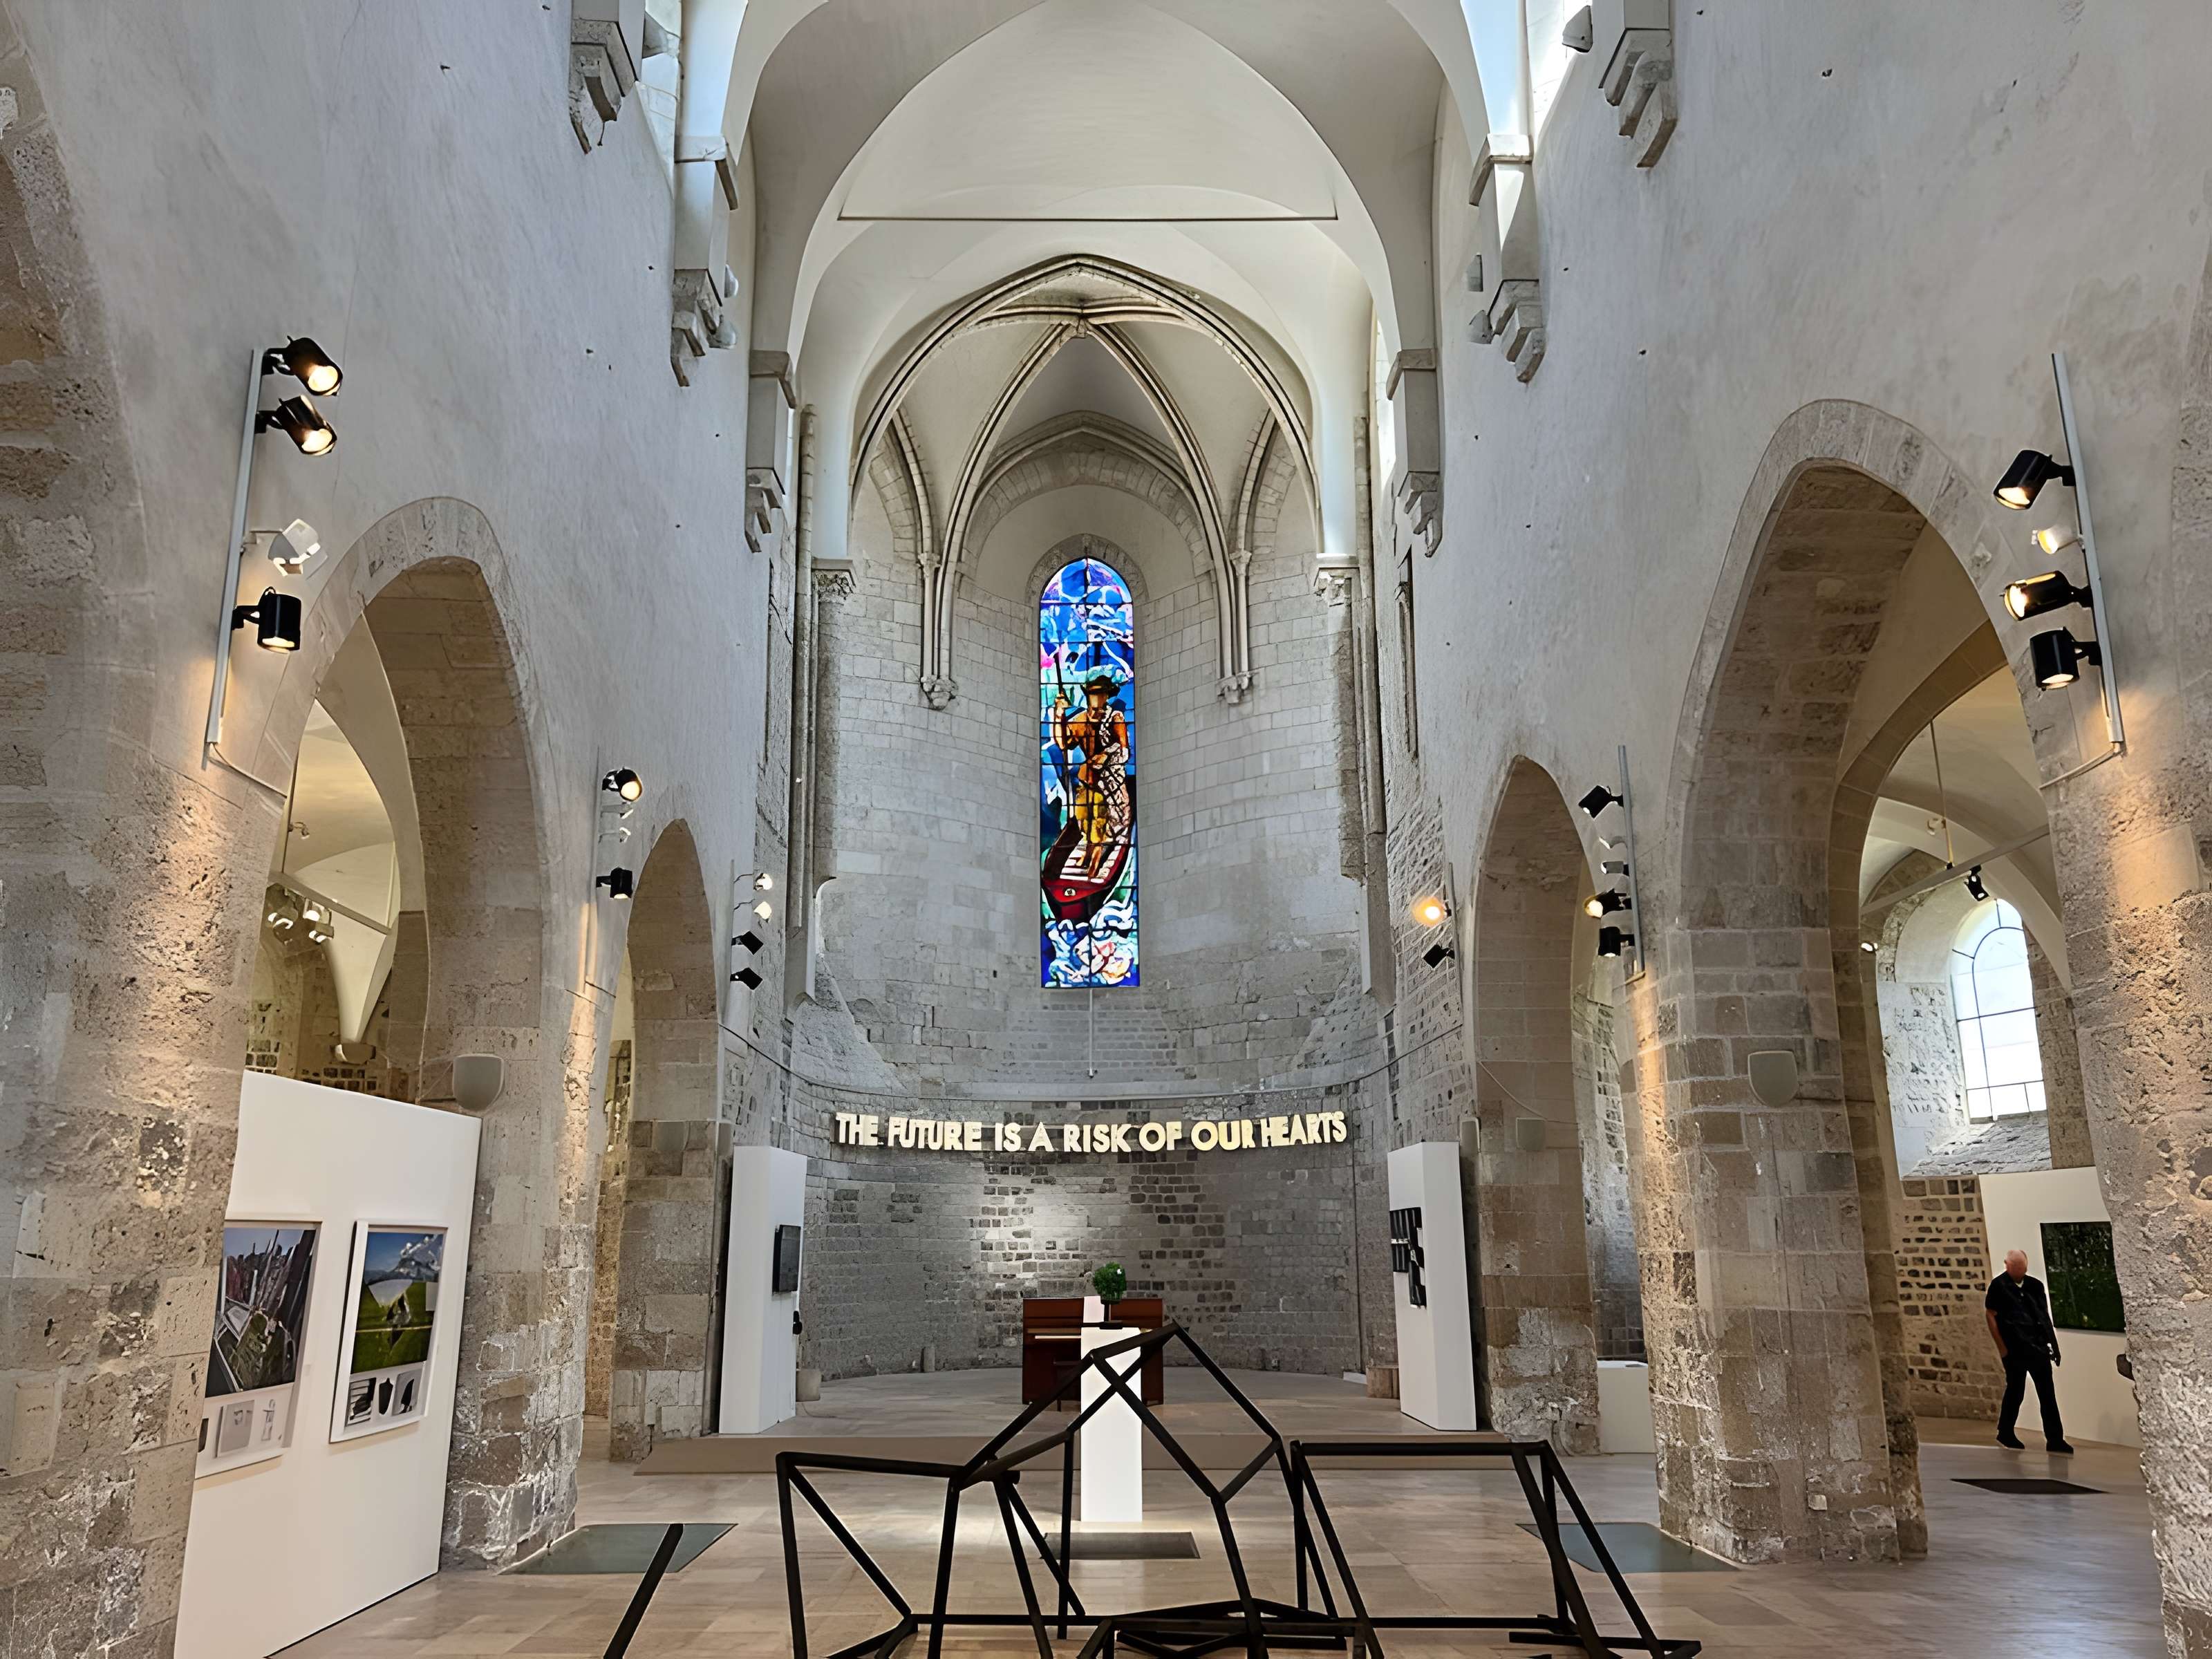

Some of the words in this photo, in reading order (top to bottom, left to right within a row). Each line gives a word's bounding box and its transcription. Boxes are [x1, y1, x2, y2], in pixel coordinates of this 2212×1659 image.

[835, 1112, 879, 1146] THE
[888, 1116, 982, 1151] FUTURE
[995, 1122, 1022, 1152] IS
[1028, 1121, 1054, 1152] A
[1063, 1124, 1132, 1153] RISK
[1138, 1121, 1182, 1152] OF
[1190, 1119, 1255, 1151] OUR
[1260, 1111, 1347, 1147] HEARTS
